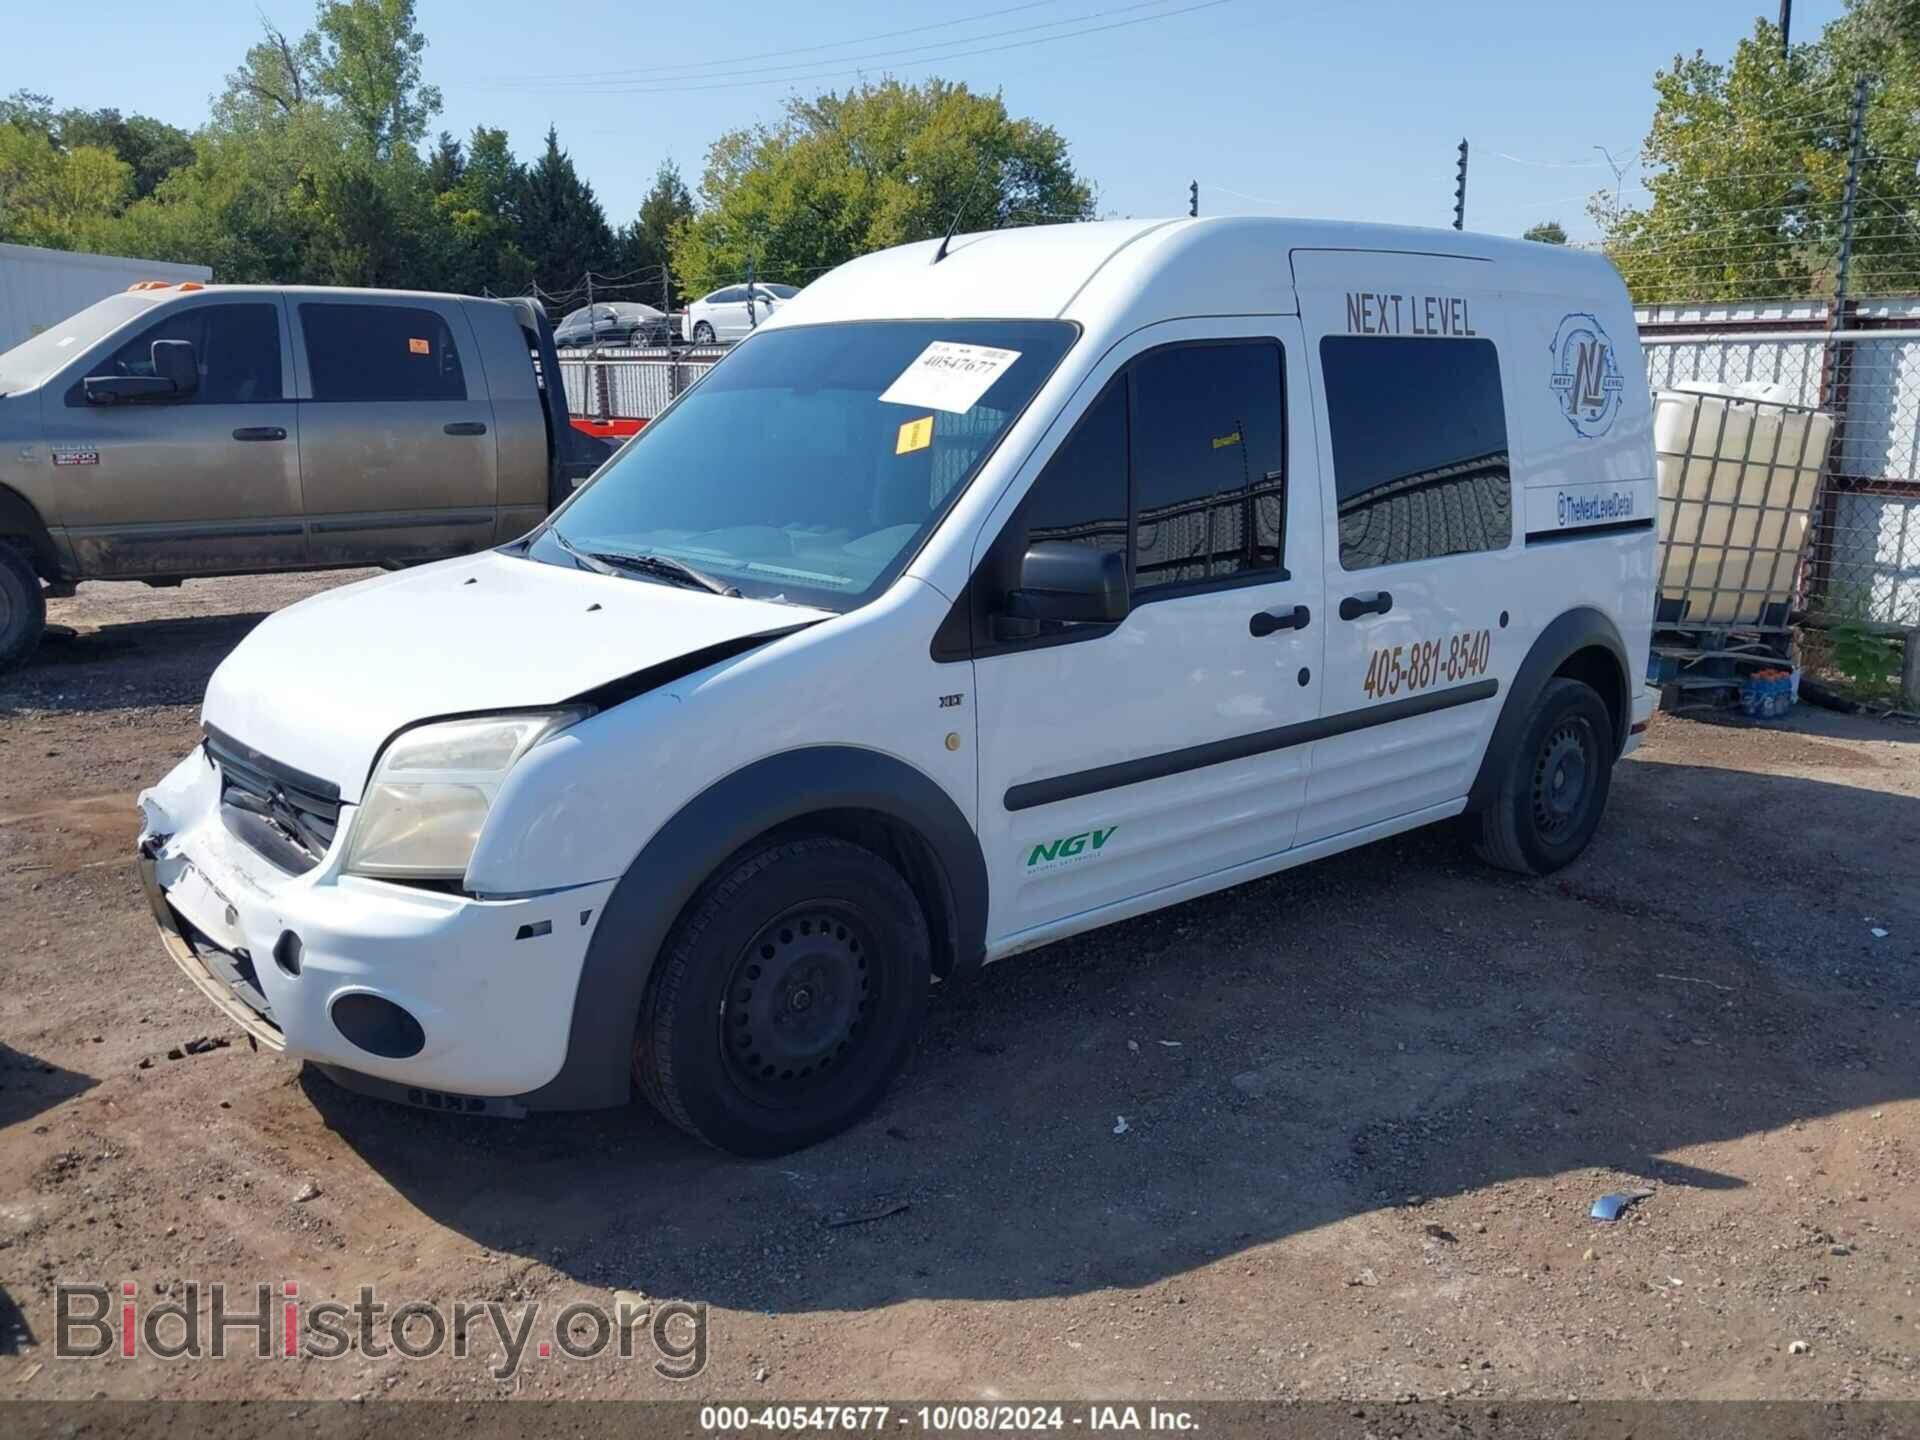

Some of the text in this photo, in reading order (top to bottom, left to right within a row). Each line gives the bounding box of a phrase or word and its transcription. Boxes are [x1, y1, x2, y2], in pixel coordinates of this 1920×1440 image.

[1345, 292, 1476, 336] NEXT LEVEL
[923, 354, 998, 374] 40547677
[1363, 629, 1491, 700] 405-881-8540
[1027, 825, 1119, 867] NGV
